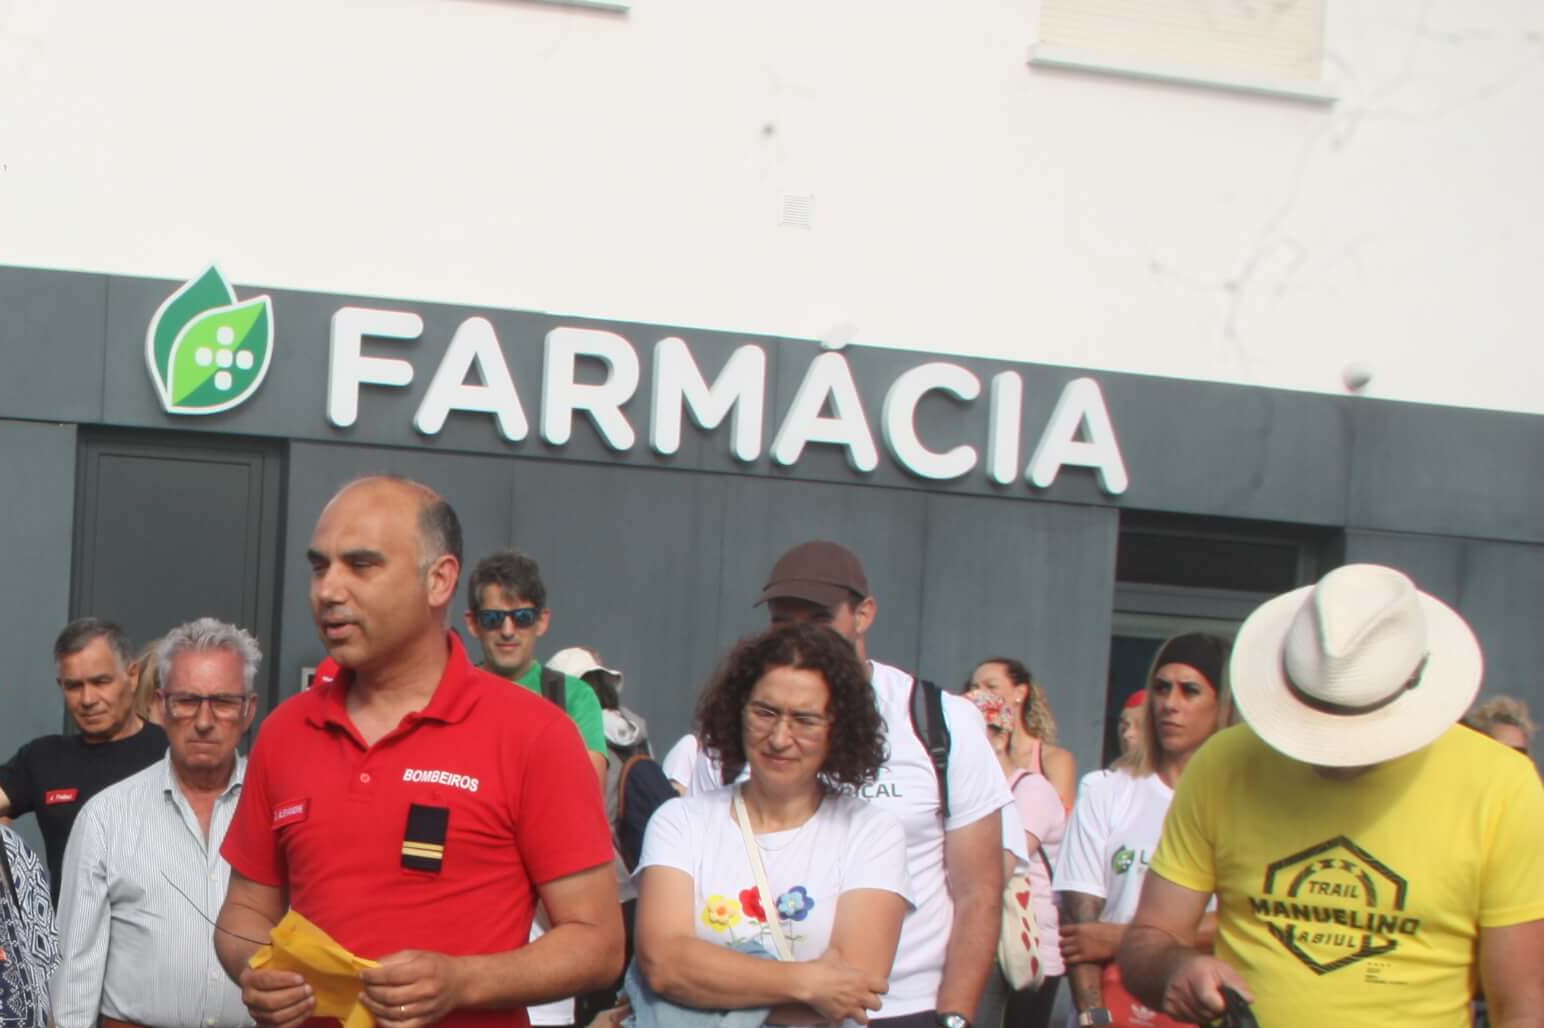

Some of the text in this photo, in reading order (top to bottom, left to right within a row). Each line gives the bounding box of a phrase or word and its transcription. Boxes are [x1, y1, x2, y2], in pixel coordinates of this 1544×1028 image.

[327, 305, 1130, 495] FARMÁCIA
[402, 768, 480, 793] BOMBEIROS
[1308, 880, 1360, 899] TRAIL
[1248, 896, 1421, 936] MANUELINO
[1297, 931, 1357, 949] ABIUL
